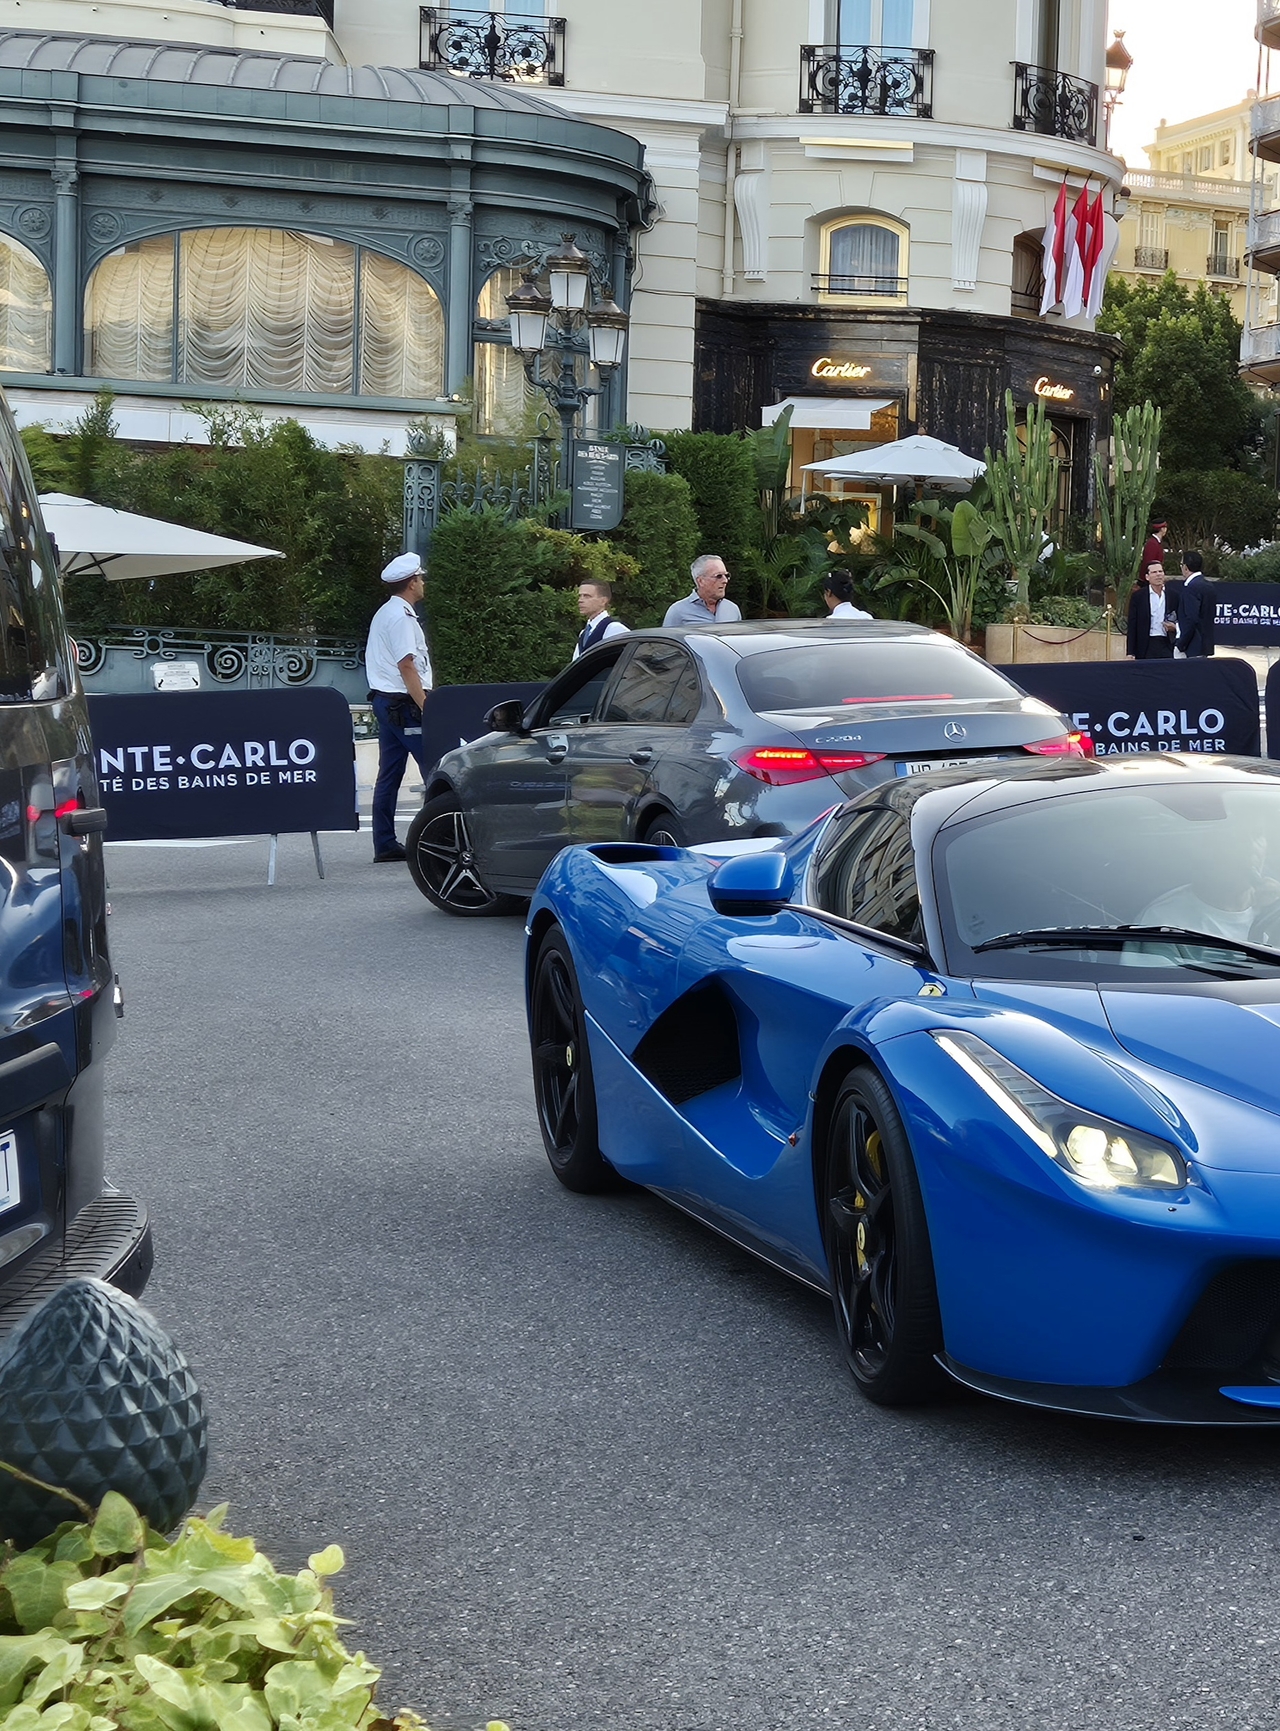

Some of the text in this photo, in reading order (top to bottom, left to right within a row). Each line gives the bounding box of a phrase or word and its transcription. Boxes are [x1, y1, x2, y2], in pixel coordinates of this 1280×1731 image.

[811, 357, 872, 378] Cartier
[1034, 376, 1074, 400] Cartier
[1095, 738, 1226, 756] BAINS DE MER
[132, 777, 170, 792] DES
[178, 773, 238, 789] BAINS
[246, 771, 271, 786] DE
[278, 769, 317, 784] MER
